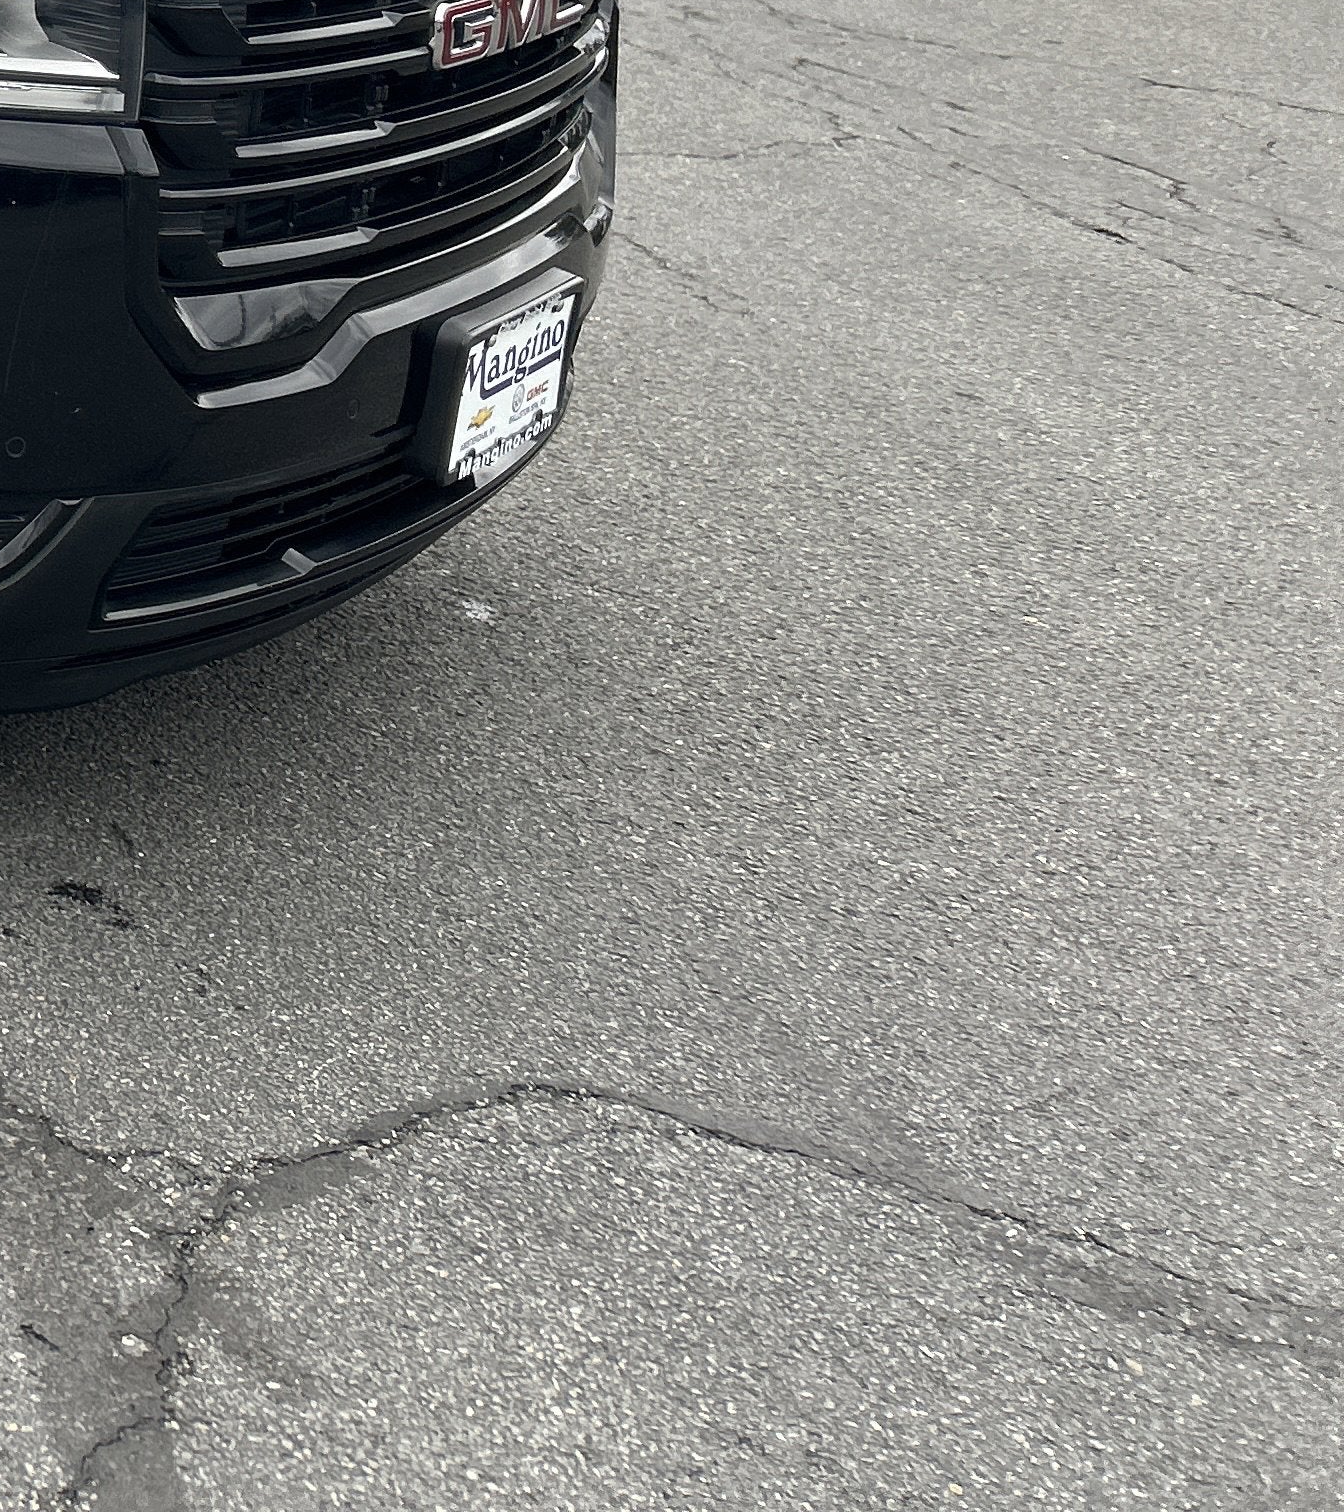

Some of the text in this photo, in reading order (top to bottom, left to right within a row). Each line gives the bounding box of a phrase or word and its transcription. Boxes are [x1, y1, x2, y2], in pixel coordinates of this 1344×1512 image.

[463, 318, 565, 400] Mangino
[526, 379, 550, 402] GMC
[457, 414, 553, 480] Mangino.com
